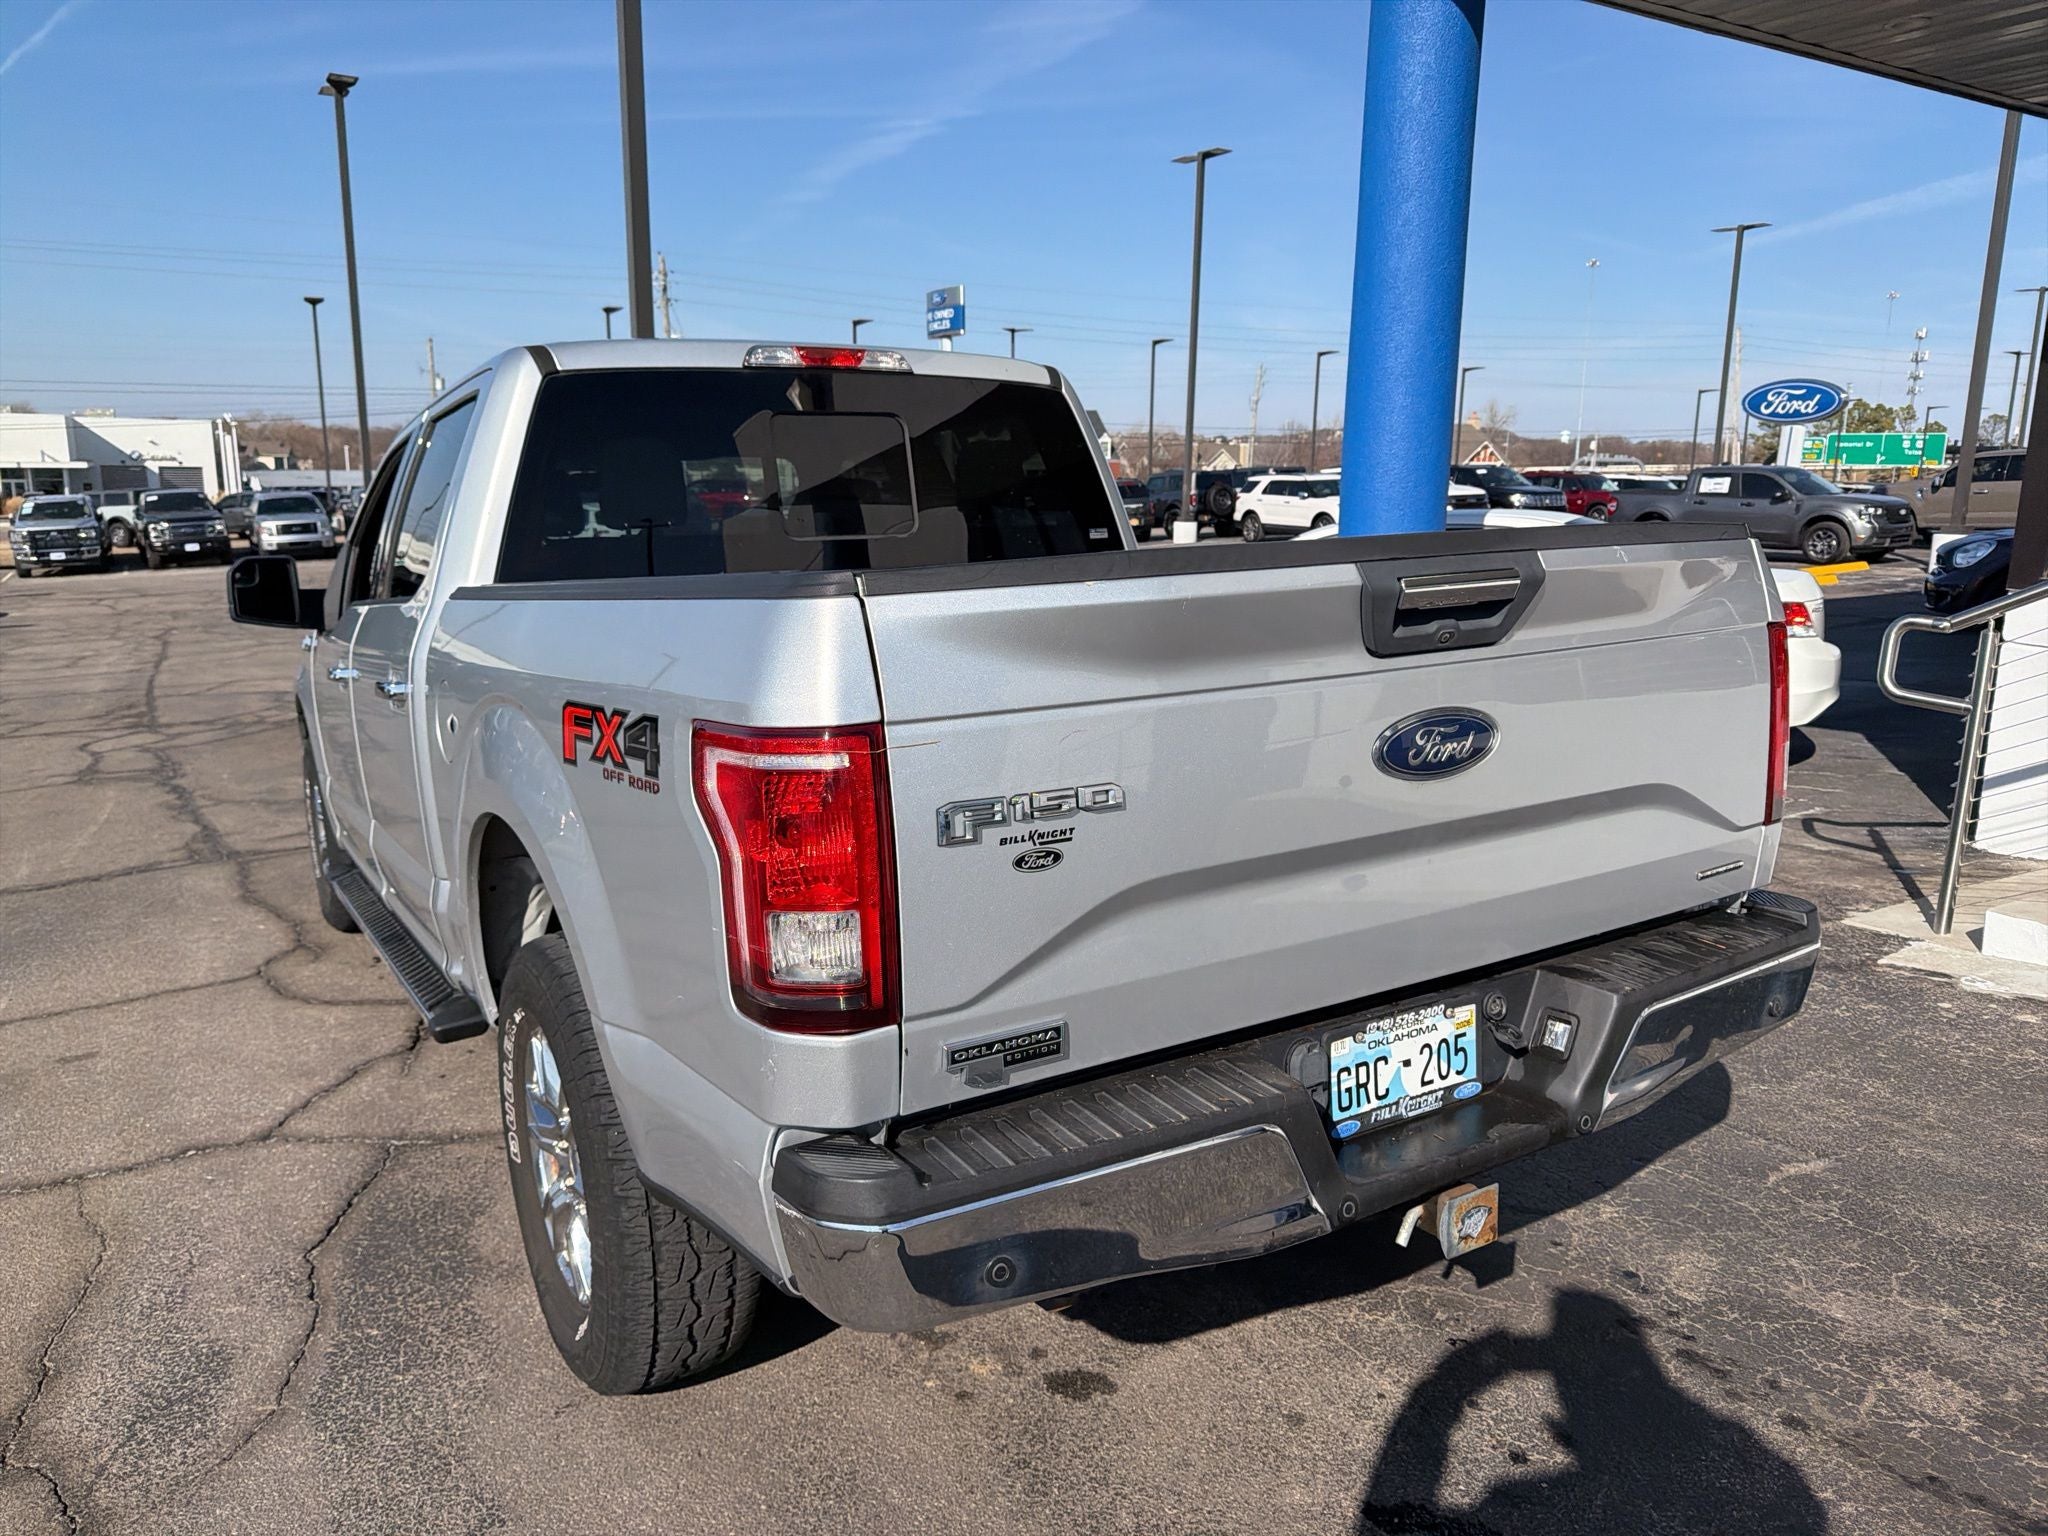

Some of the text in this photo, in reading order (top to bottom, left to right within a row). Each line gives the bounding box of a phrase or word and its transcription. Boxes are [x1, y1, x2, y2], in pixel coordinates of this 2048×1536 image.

[1759, 388, 1822, 415] Ford
[562, 699, 660, 780] FX4
[1407, 724, 1476, 767] Ford
[602, 767, 661, 795] OFF ROAD
[936, 781, 1127, 848] F150
[1020, 851, 1054, 869] Ford
[1366, 1004, 1445, 1035] (918) 526-2400
[954, 1030, 1058, 1061] OKLAHOMA
[1367, 1023, 1438, 1050] OKLAHOMA
[1006, 1044, 1057, 1062] EDITION
[1336, 1032, 1468, 1113] GRC 205
[503, 1018, 521, 1164] DUELER
